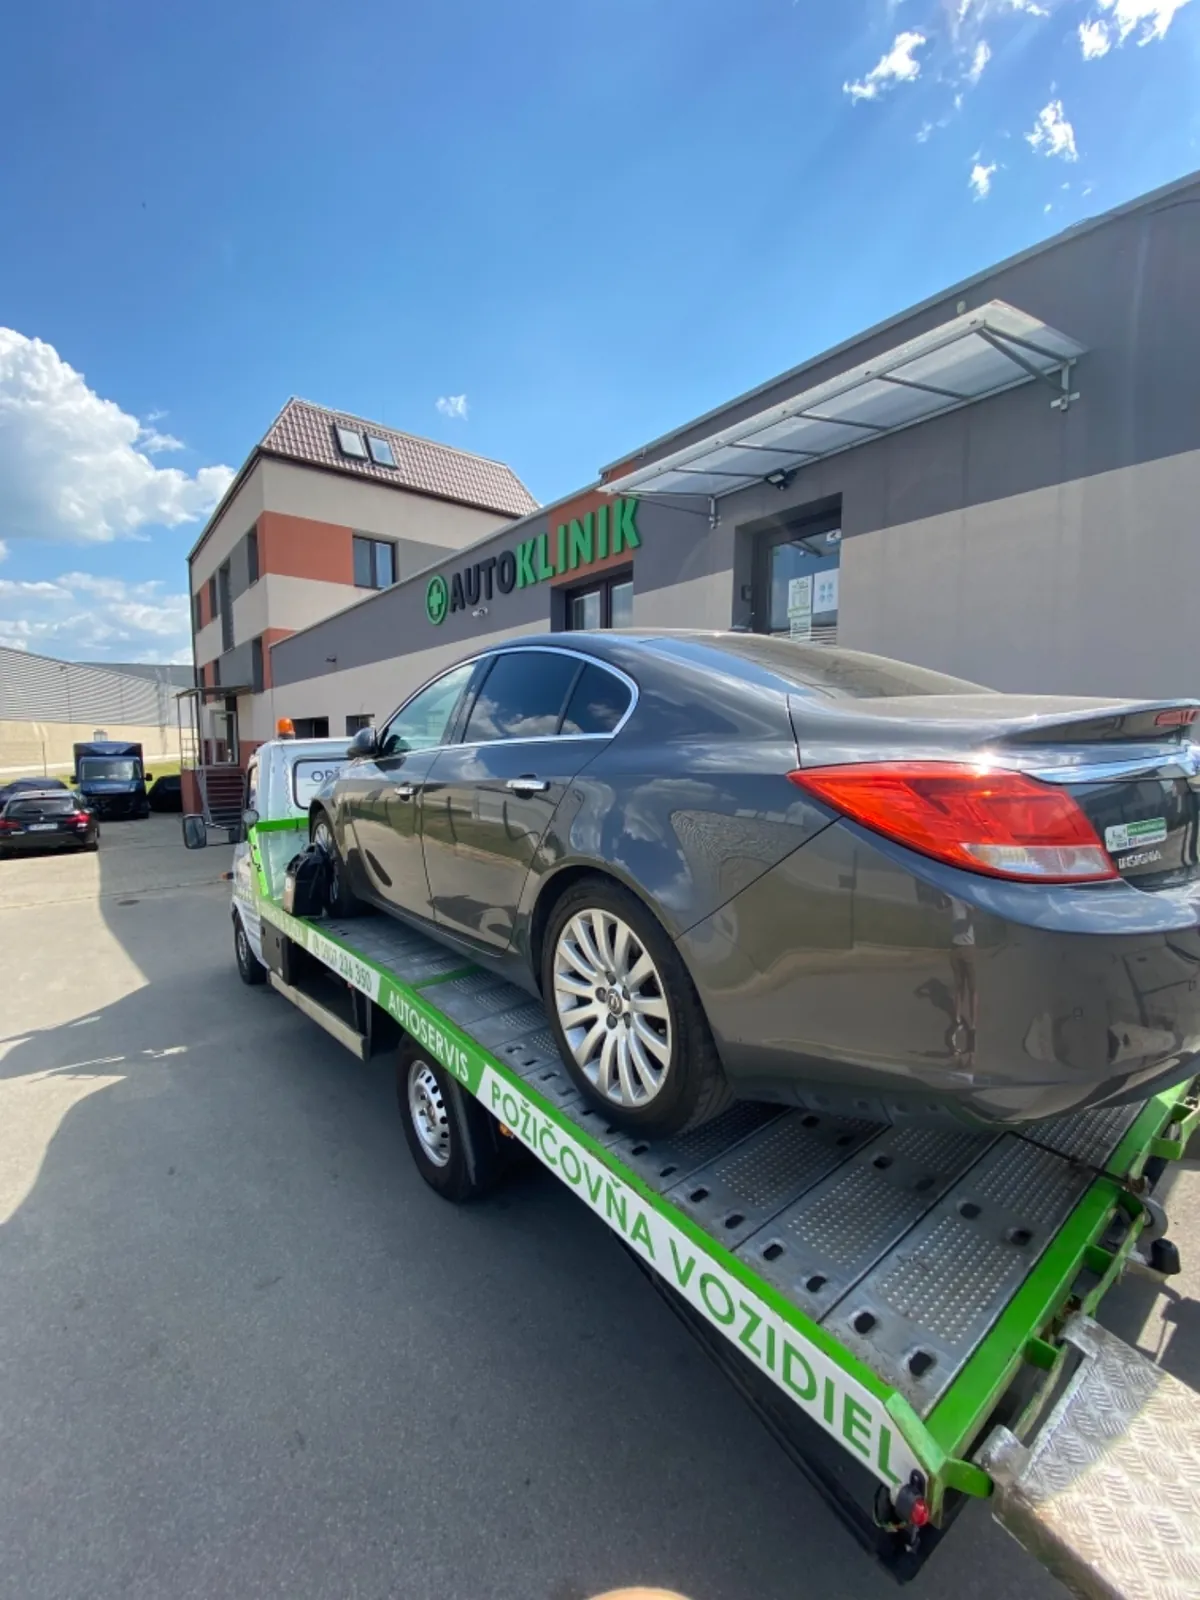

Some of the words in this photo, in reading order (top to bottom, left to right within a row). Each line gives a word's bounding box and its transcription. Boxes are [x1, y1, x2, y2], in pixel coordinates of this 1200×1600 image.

[449, 494, 641, 613] AUTOKLINIK
[388, 989, 469, 1083] AUTOSERVIS
[491, 1080, 656, 1261] POŽIČOVŇA
[669, 1237, 903, 1485] VOZIDIEL
